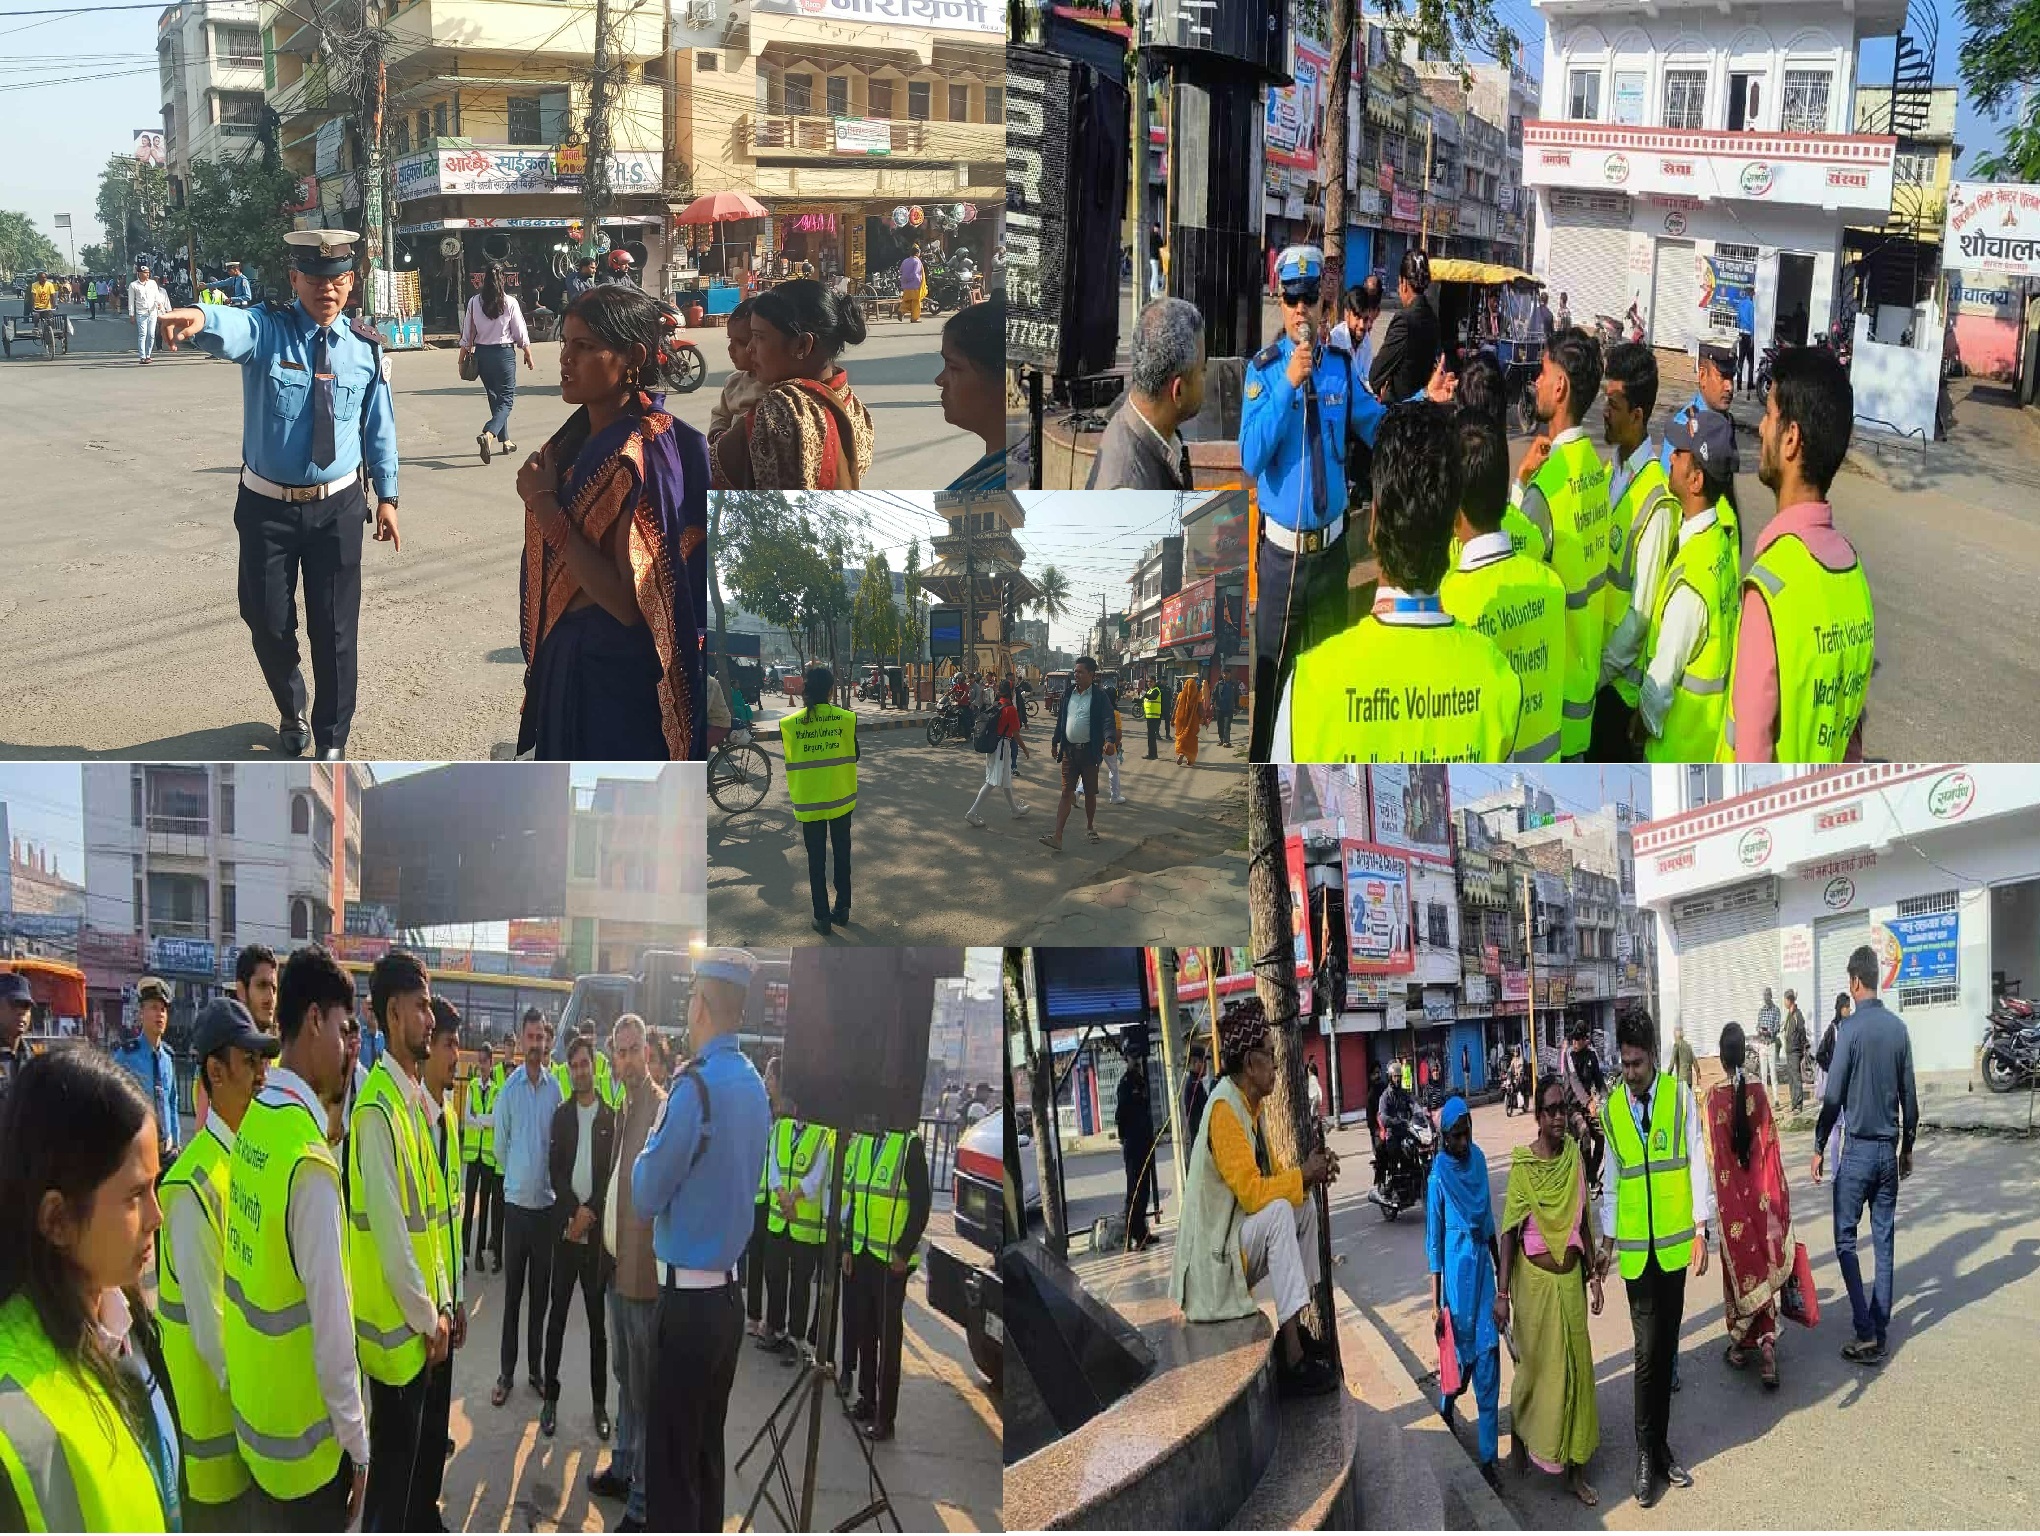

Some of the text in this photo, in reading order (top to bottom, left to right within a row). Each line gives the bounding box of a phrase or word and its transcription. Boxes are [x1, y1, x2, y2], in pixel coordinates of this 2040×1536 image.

[1960, 227, 2040, 261] शौचाल
[1497, 598, 1545, 632] Volunteer
[1345, 685, 1481, 723] Traffic Volunteer
